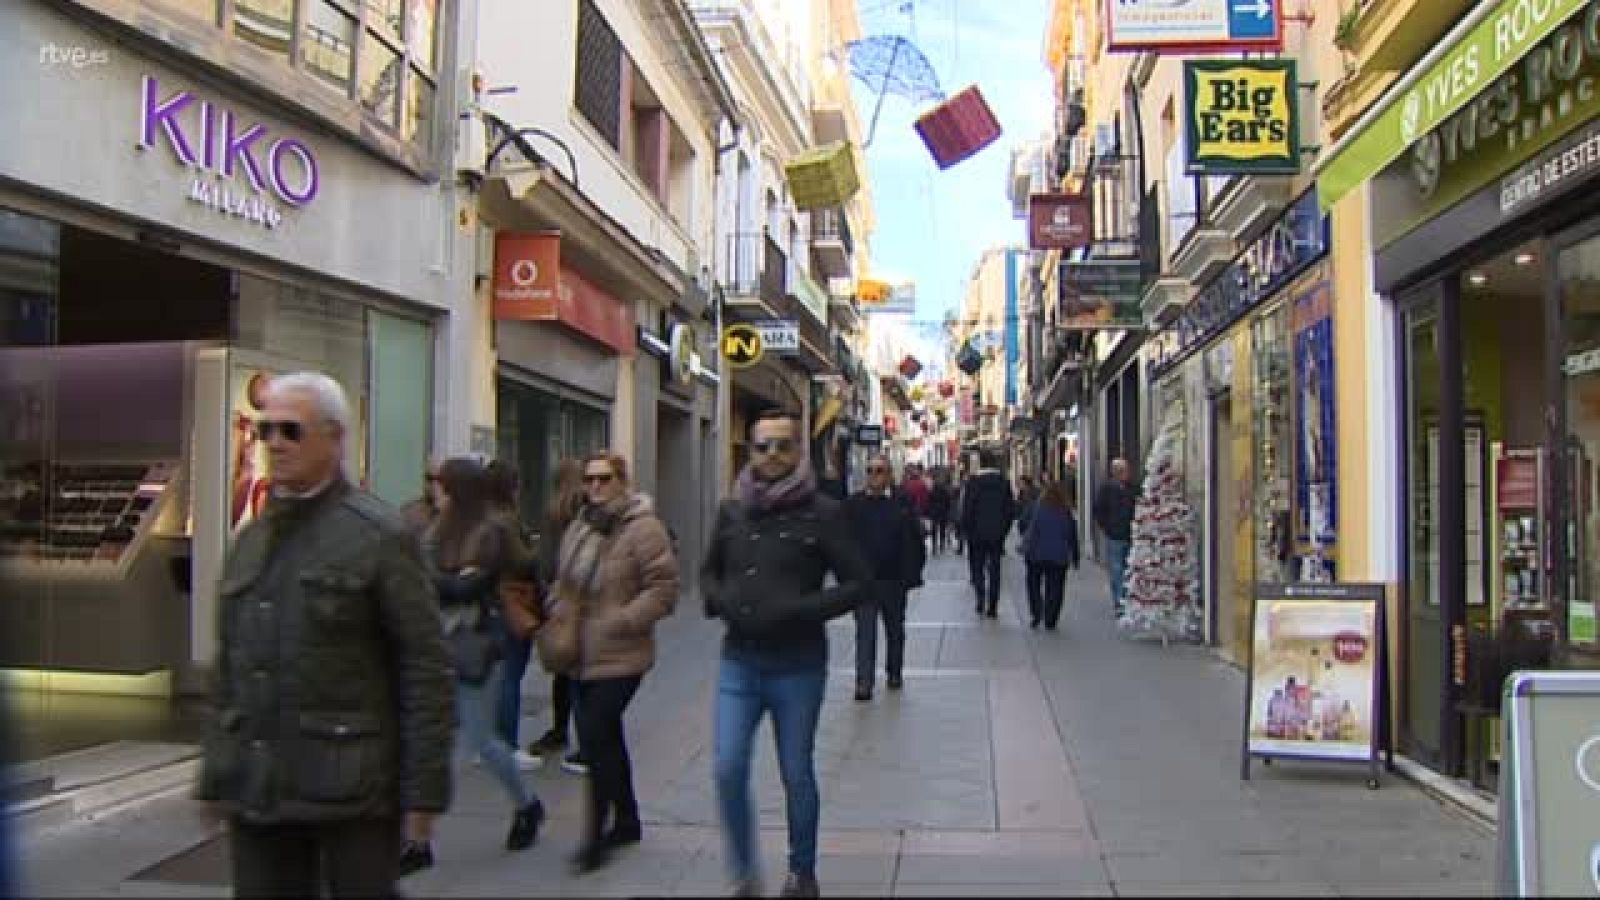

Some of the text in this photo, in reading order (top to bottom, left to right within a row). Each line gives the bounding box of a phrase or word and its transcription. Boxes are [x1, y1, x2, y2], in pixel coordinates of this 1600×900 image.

[1208, 78, 1276, 119] Big
[1427, 44, 1480, 120] YVES
[139, 75, 319, 206] KIKO
[1544, 157, 1560, 186] DE
[191, 179, 281, 228] MILANO
[726, 335, 757, 356] IN
